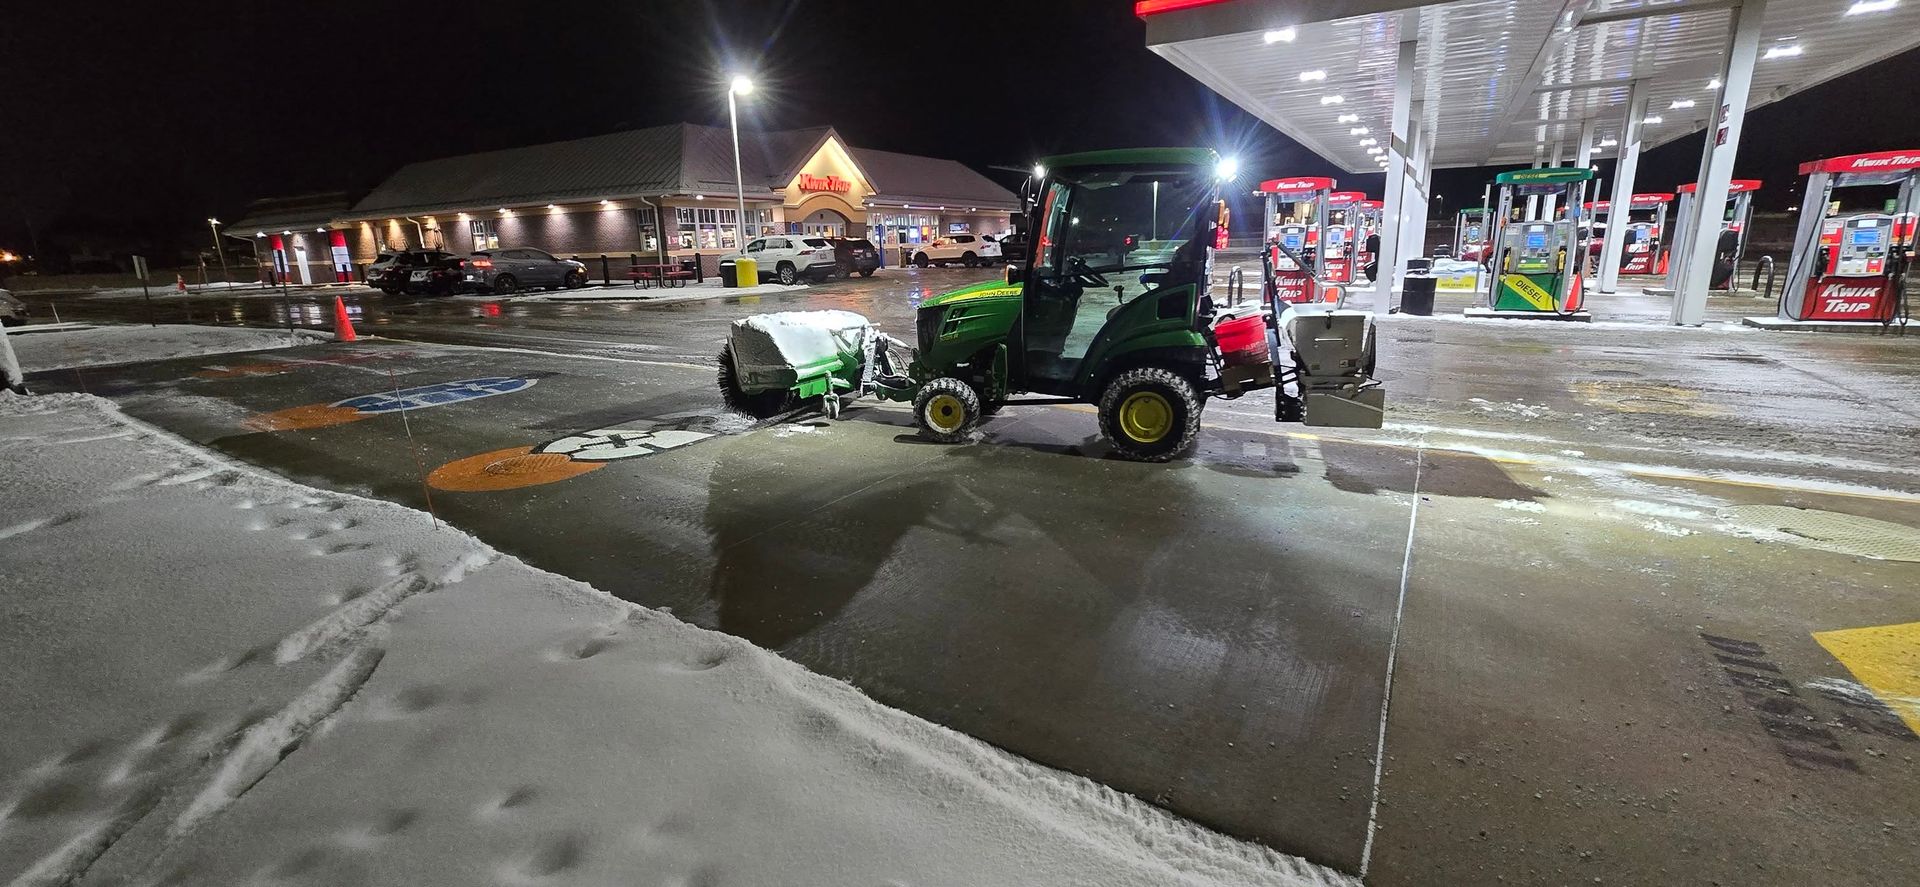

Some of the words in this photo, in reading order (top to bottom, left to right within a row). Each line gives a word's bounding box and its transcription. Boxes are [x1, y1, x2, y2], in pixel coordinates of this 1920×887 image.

[1851, 158, 1891, 167] KWIK
[800, 173, 830, 190] KWIK
[828, 176, 852, 192] TRIP
[1275, 276, 1306, 286] KWIK
[1277, 287, 1302, 298] TRIP
[1515, 279, 1543, 303] DIESEL
[1821, 284, 1880, 297] KWIK
[1824, 300, 1871, 312] TRIP
